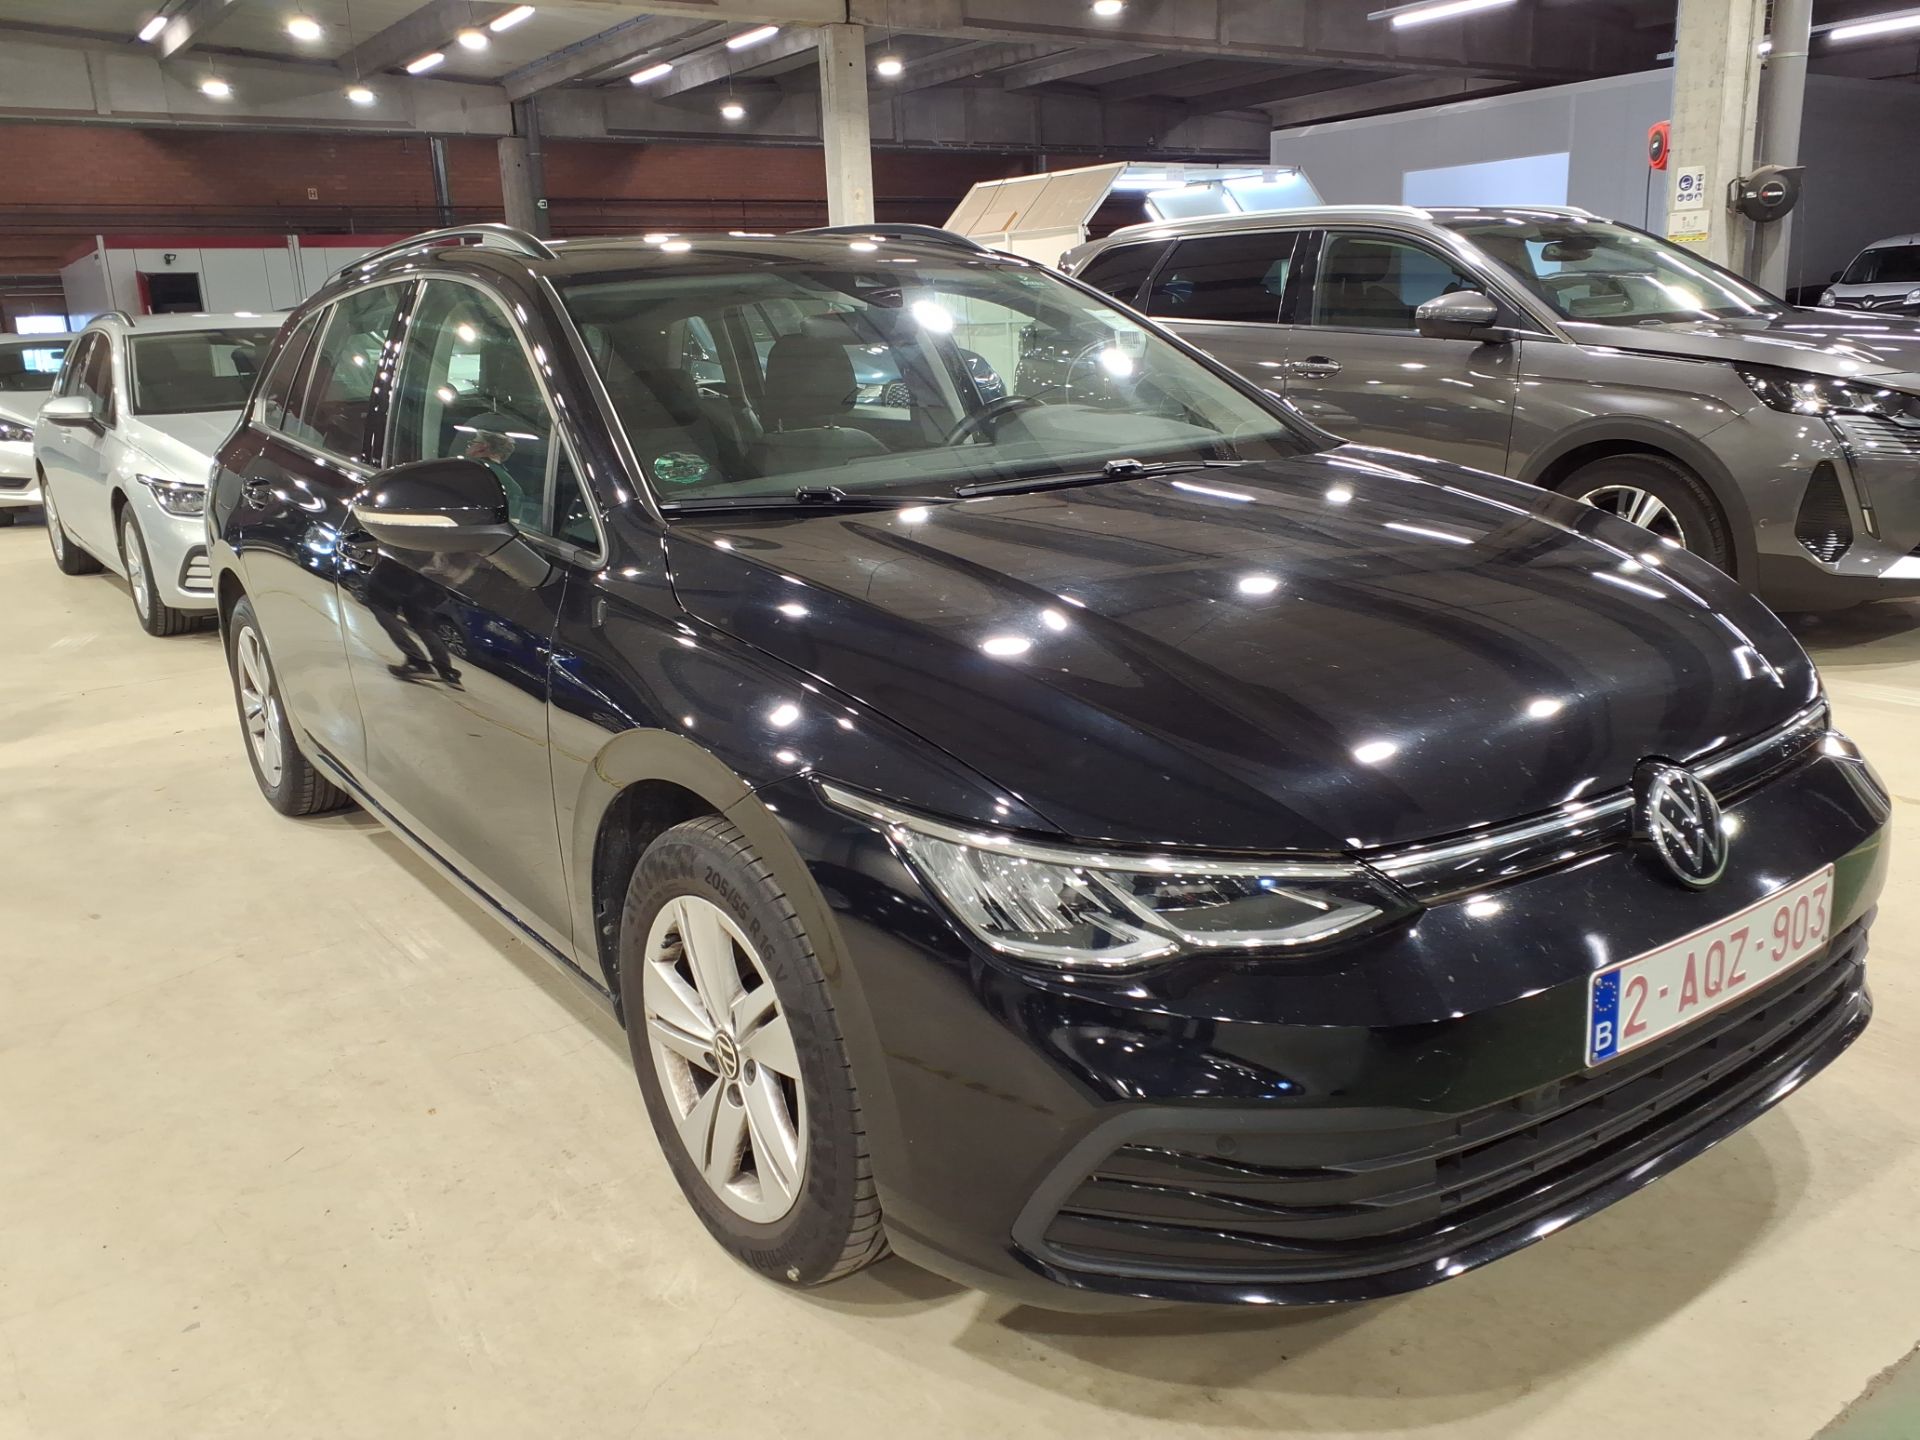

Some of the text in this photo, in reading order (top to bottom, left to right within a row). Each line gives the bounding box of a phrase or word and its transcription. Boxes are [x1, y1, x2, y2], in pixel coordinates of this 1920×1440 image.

[705, 866, 788, 982] 205/55 R 16 V
[1623, 882, 1828, 1039] 2-AQZ-903
[1595, 1021, 1612, 1051] B
